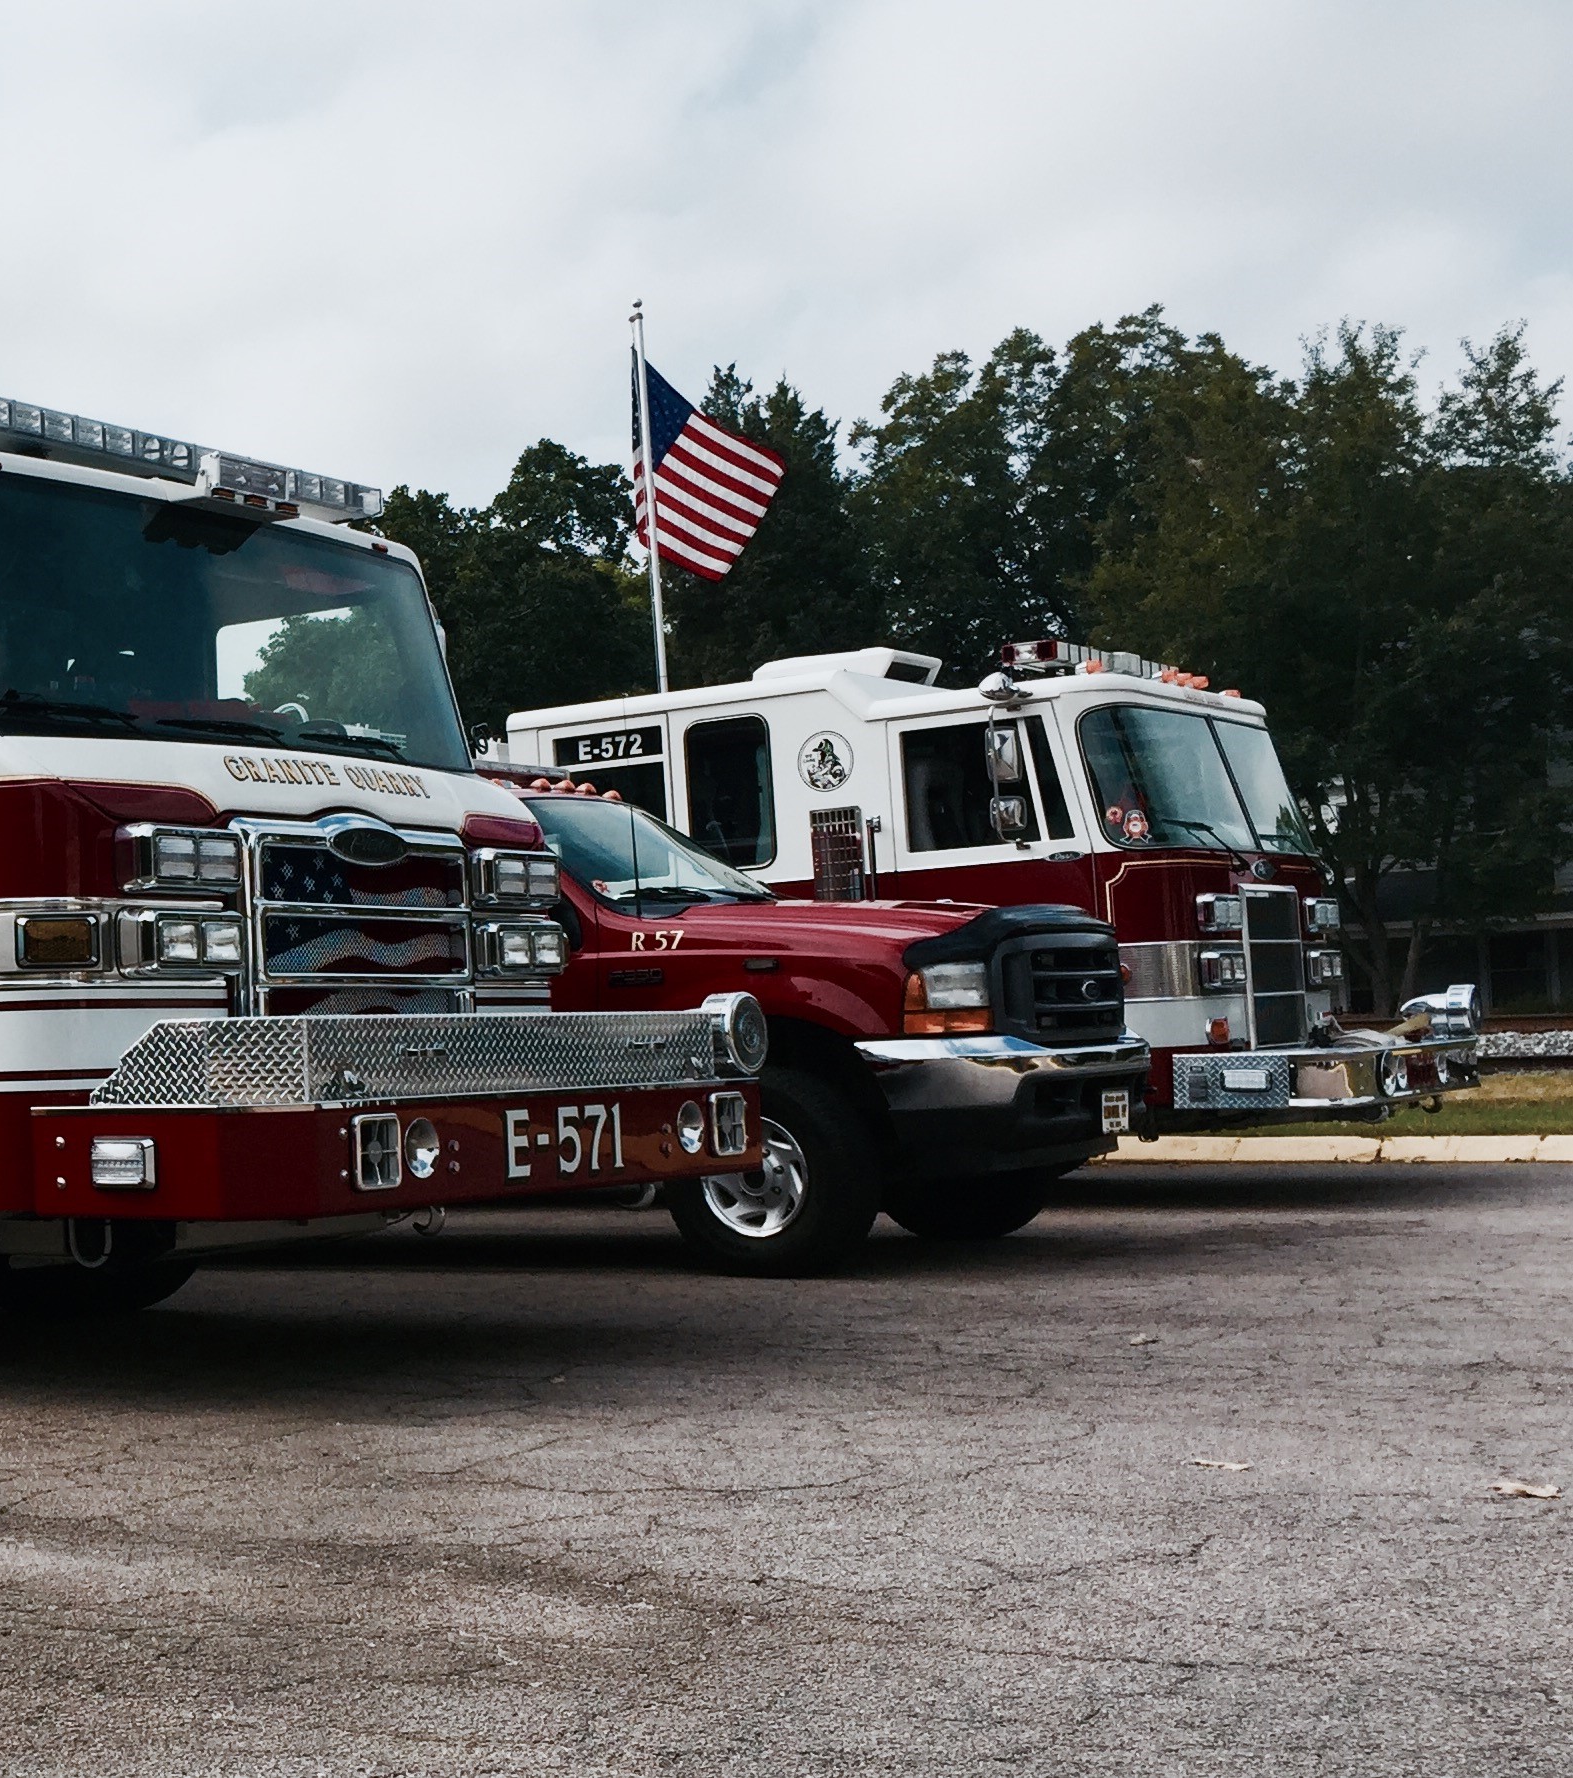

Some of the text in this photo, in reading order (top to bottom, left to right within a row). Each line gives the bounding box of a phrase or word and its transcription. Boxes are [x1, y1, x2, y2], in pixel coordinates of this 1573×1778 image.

[578, 733, 644, 762] E-572
[223, 755, 431, 799] GRANITE QUARRY
[631, 929, 685, 951] R 57
[505, 1102, 624, 1178] E-571
